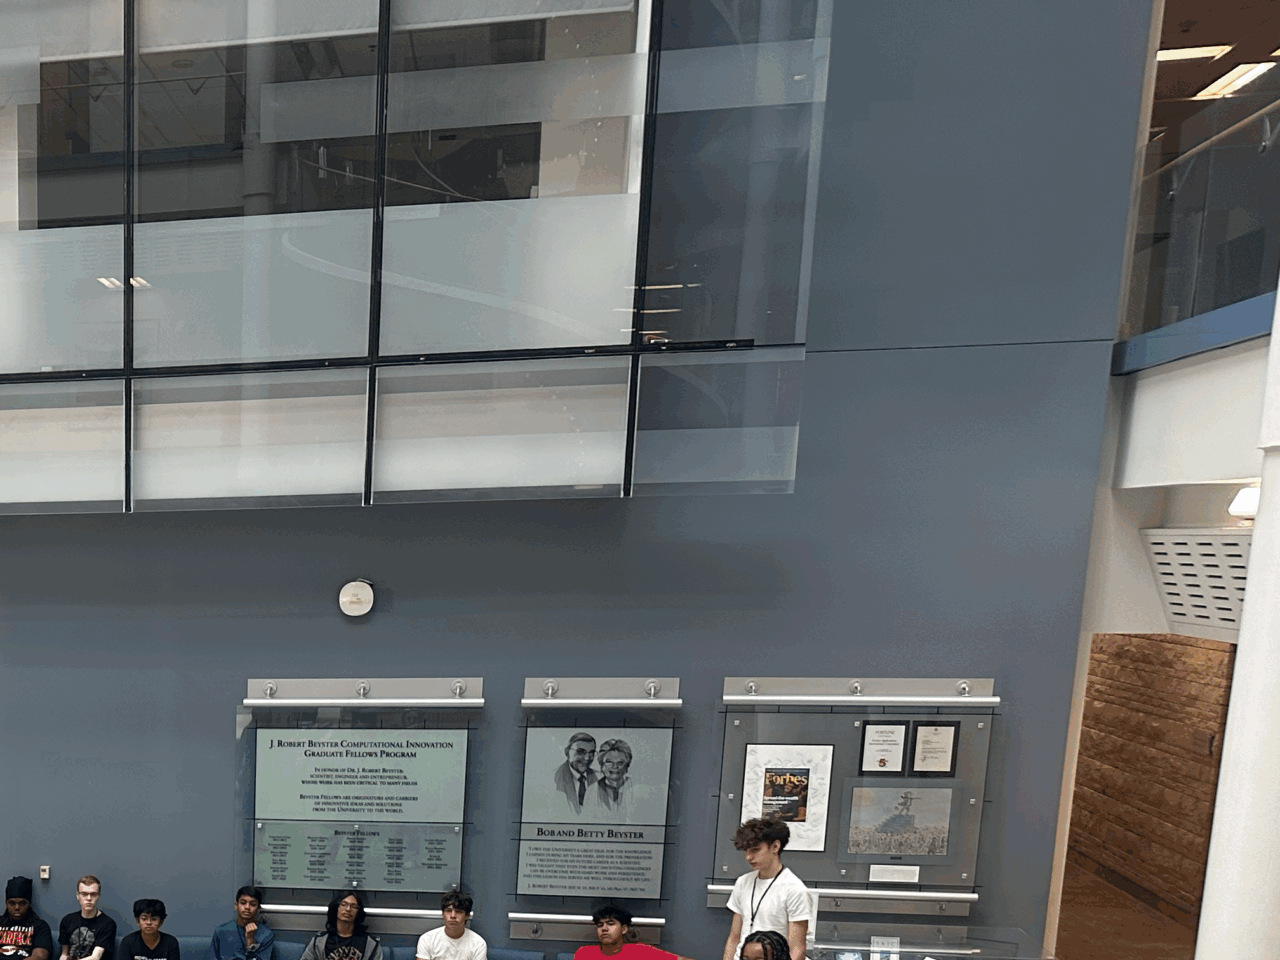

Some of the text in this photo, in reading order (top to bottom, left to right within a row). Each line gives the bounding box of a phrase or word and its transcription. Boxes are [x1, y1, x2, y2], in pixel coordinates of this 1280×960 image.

[277, 740, 306, 748] ROBERT
[308, 740, 339, 748] BEYSTER
[340, 740, 404, 748] COMPUTATIONAL
[406, 740, 453, 748] INNOVATION
[304, 749, 417, 758] GRADUATE FELLOWS PROGRAM
[765, 772, 808, 786] Forbes
[536, 827, 645, 839] BOB AND BETTY BEYSTER
